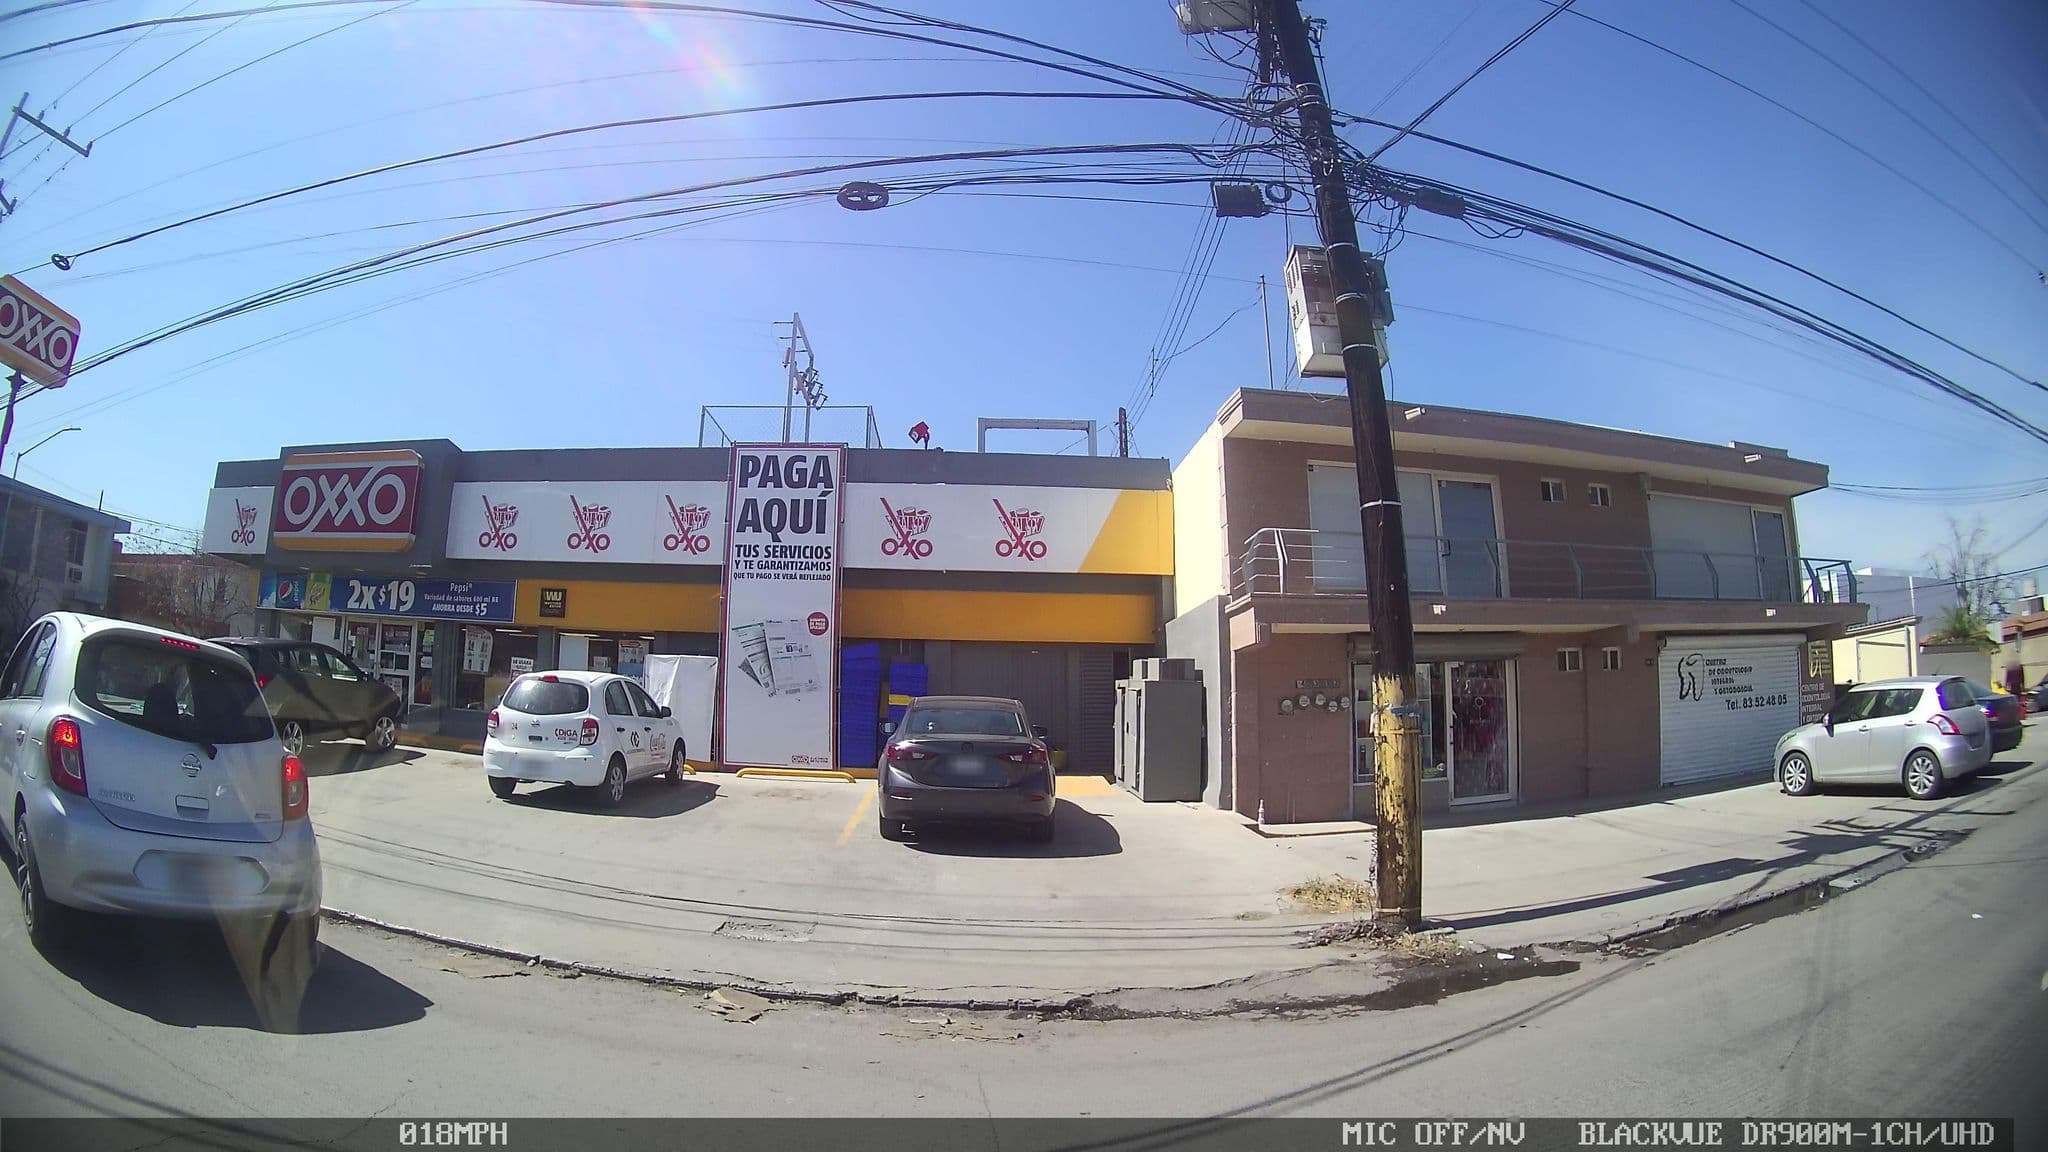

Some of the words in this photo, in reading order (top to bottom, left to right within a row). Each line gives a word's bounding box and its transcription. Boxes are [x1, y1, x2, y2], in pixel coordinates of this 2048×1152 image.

[0, 294, 72, 368] OXXO
[738, 454, 834, 489] PAGA
[284, 468, 406, 531] OXXO
[736, 490, 834, 543] AQUÍ
[735, 544, 760, 558] TUS
[764, 545, 832, 560] SERVICIOS
[734, 560, 741, 570] Y
[743, 560, 754, 570] TE
[757, 560, 832, 571] GARANTIZAMOS
[746, 572, 755, 580] TU
[799, 573, 832, 581] REFLEJADO
[432, 603, 455, 612] AHORRA
[456, 604, 473, 613] DESDE
[475, 603, 487, 617] $5
[1725, 699, 1741, 710] Tel.
[1742, 697, 1753, 708] 83
[1755, 696, 1765, 707] 52
[1766, 695, 1776, 706] 48
[1778, 694, 1788, 705] 05
